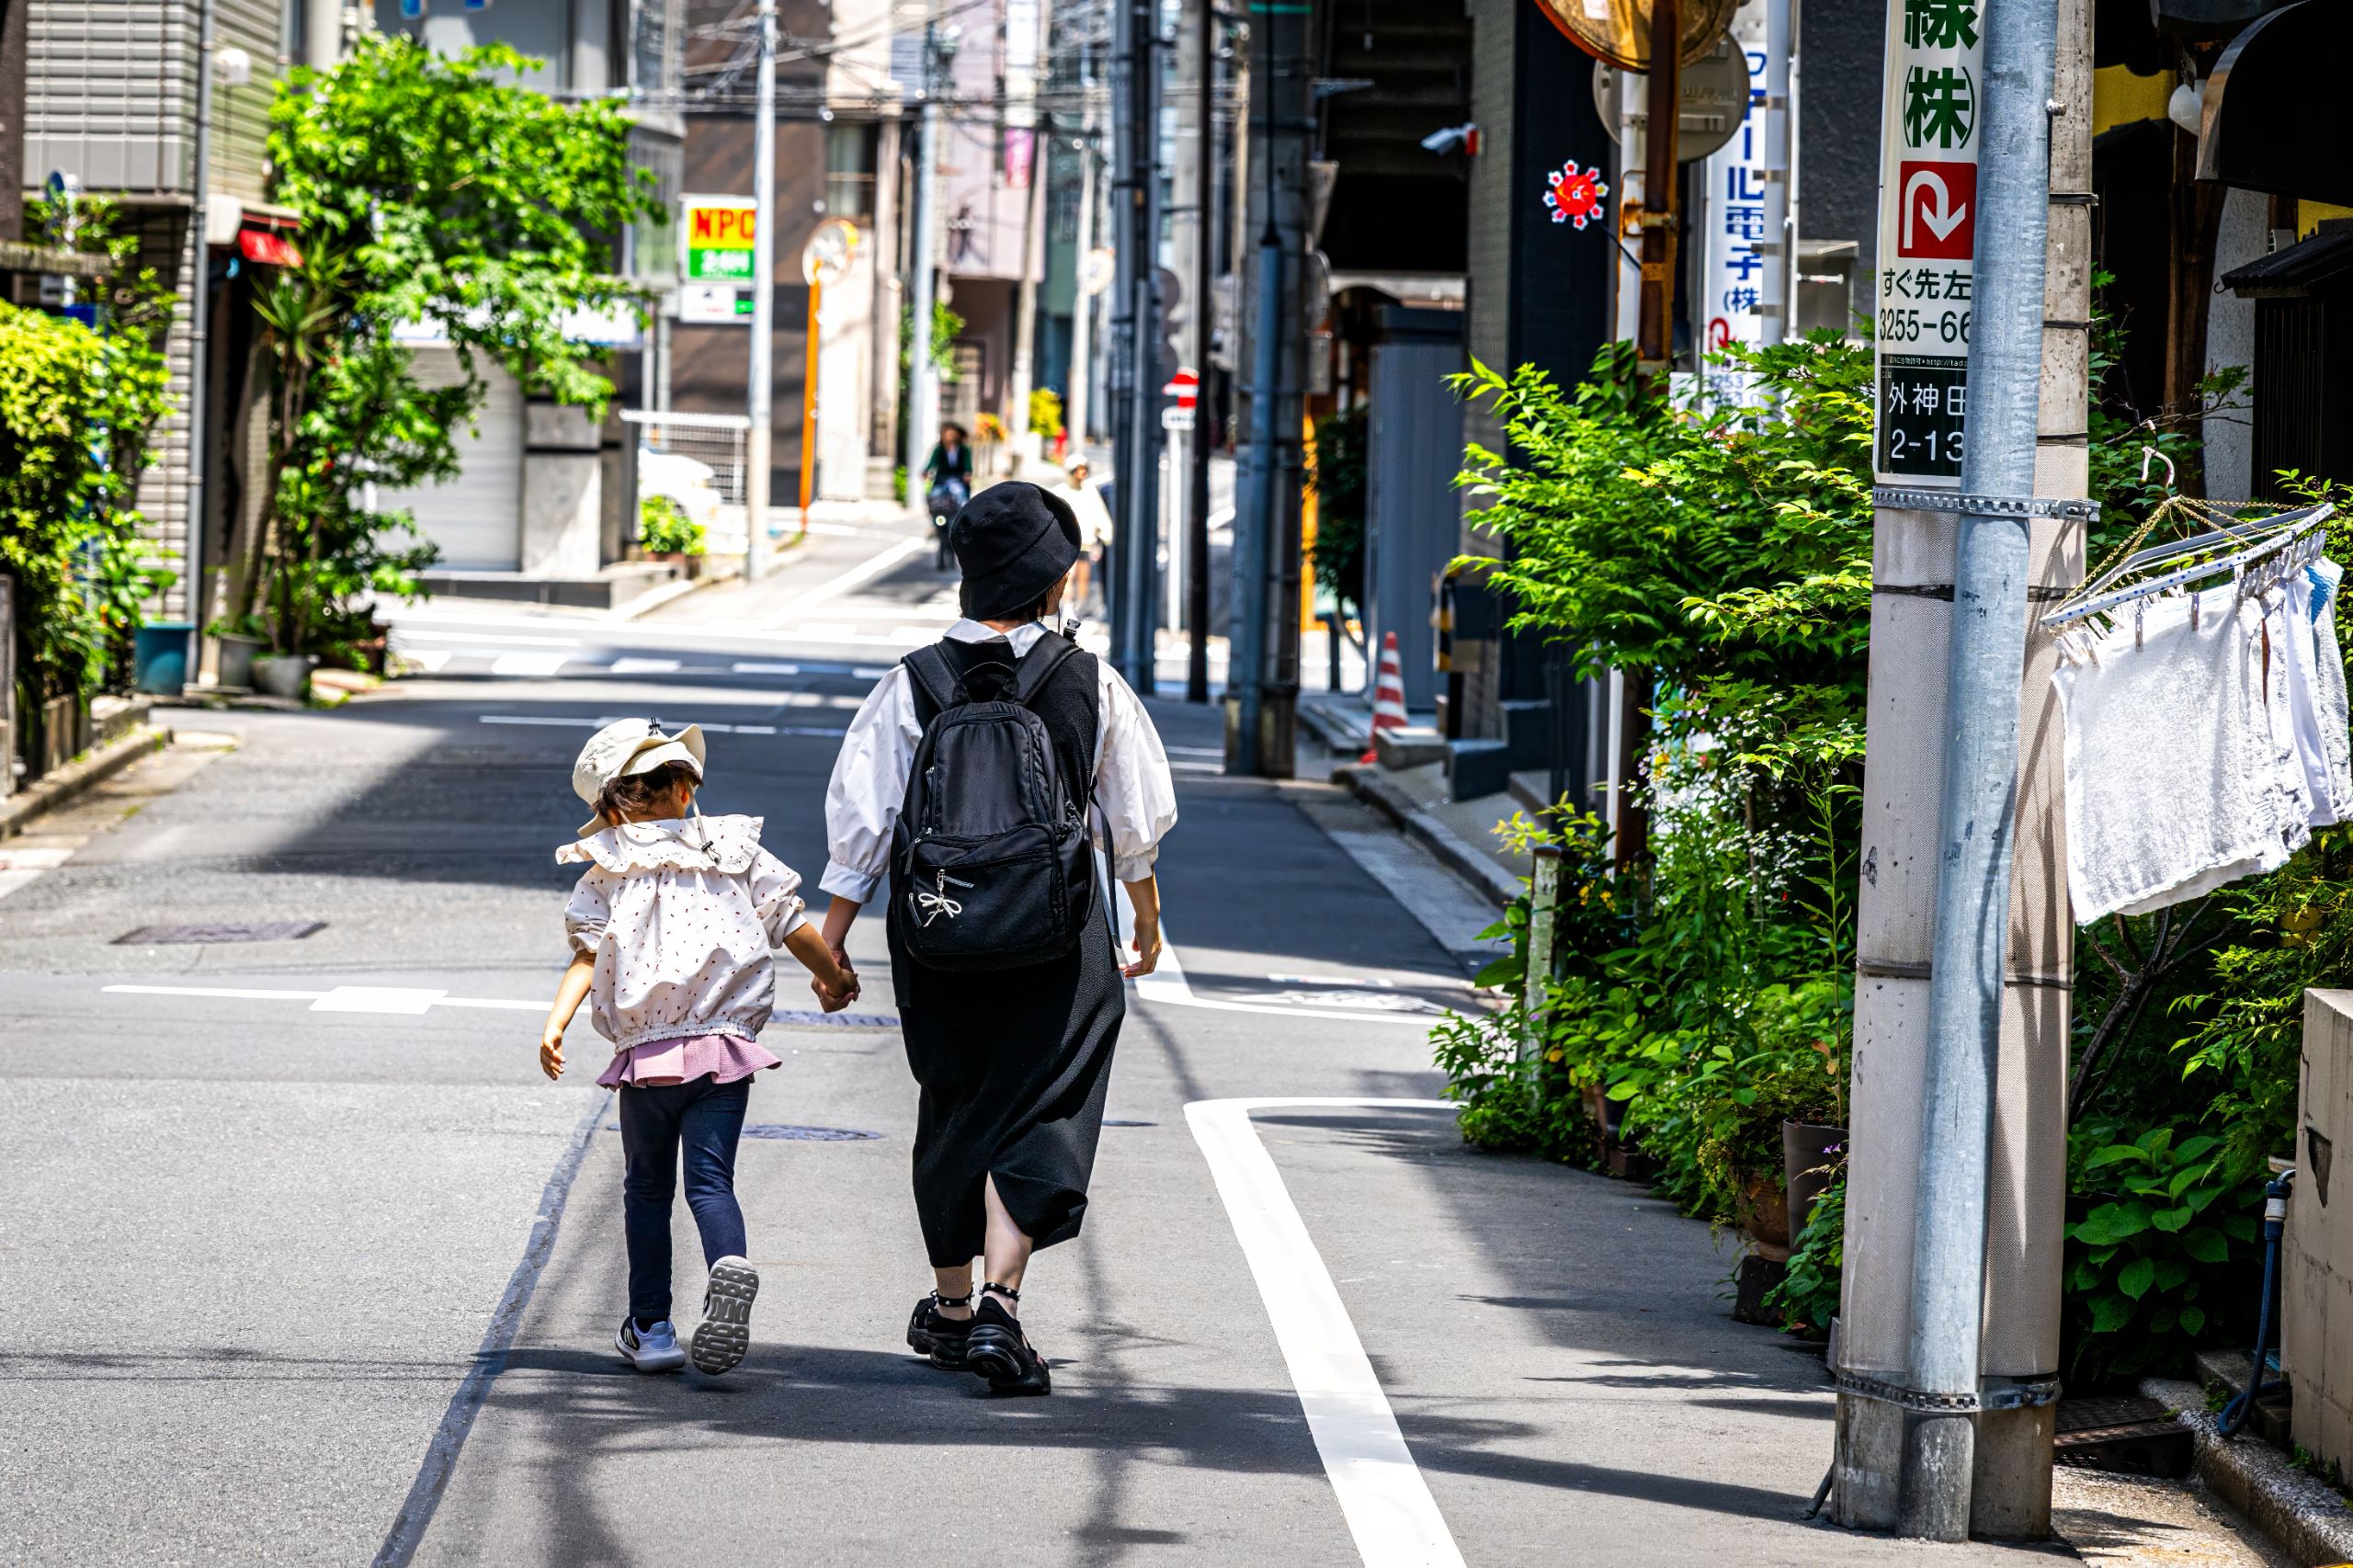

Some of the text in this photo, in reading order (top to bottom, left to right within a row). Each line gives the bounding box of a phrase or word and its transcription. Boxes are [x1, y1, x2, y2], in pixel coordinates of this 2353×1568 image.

[1883, 267, 1972, 301] すぐ先左
[1888, 382, 1966, 415] 外神田
[1891, 428, 1963, 460] 2-13
